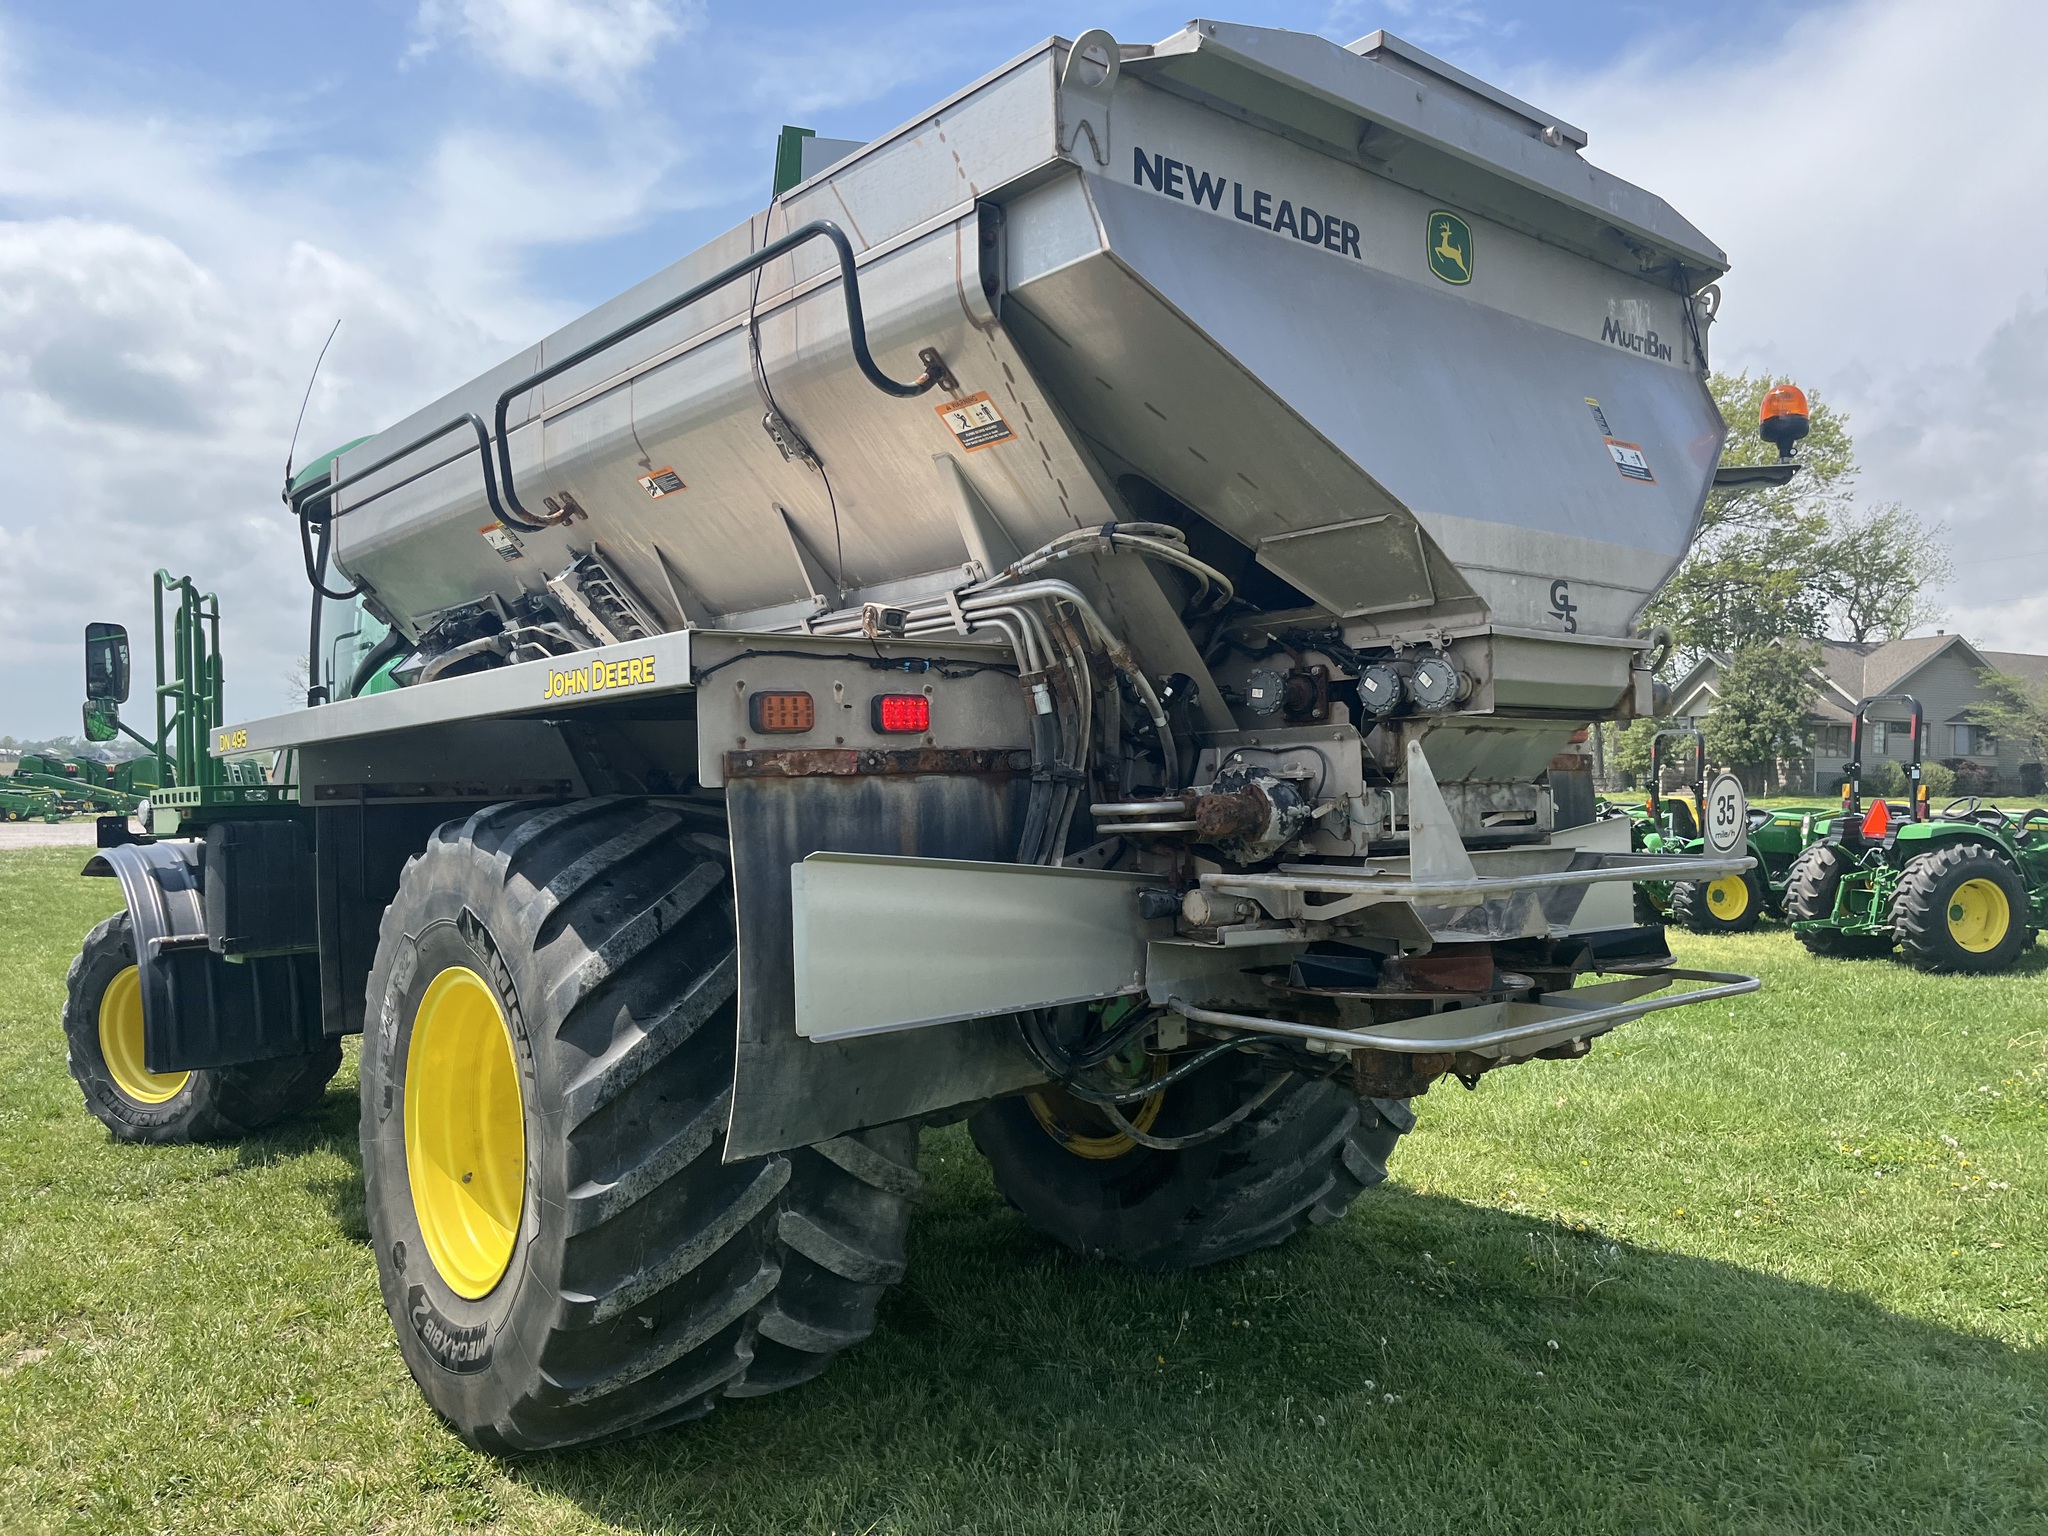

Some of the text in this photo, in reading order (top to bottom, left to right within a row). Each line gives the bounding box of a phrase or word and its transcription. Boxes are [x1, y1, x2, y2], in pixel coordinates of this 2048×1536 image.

[1133, 146, 1362, 260] NEW LEADER
[544, 655, 655, 700] JOHN DEERE
[219, 728, 248, 752] DN 495
[1716, 794, 1736, 826] 35
[1714, 829, 1736, 840] mile/h
